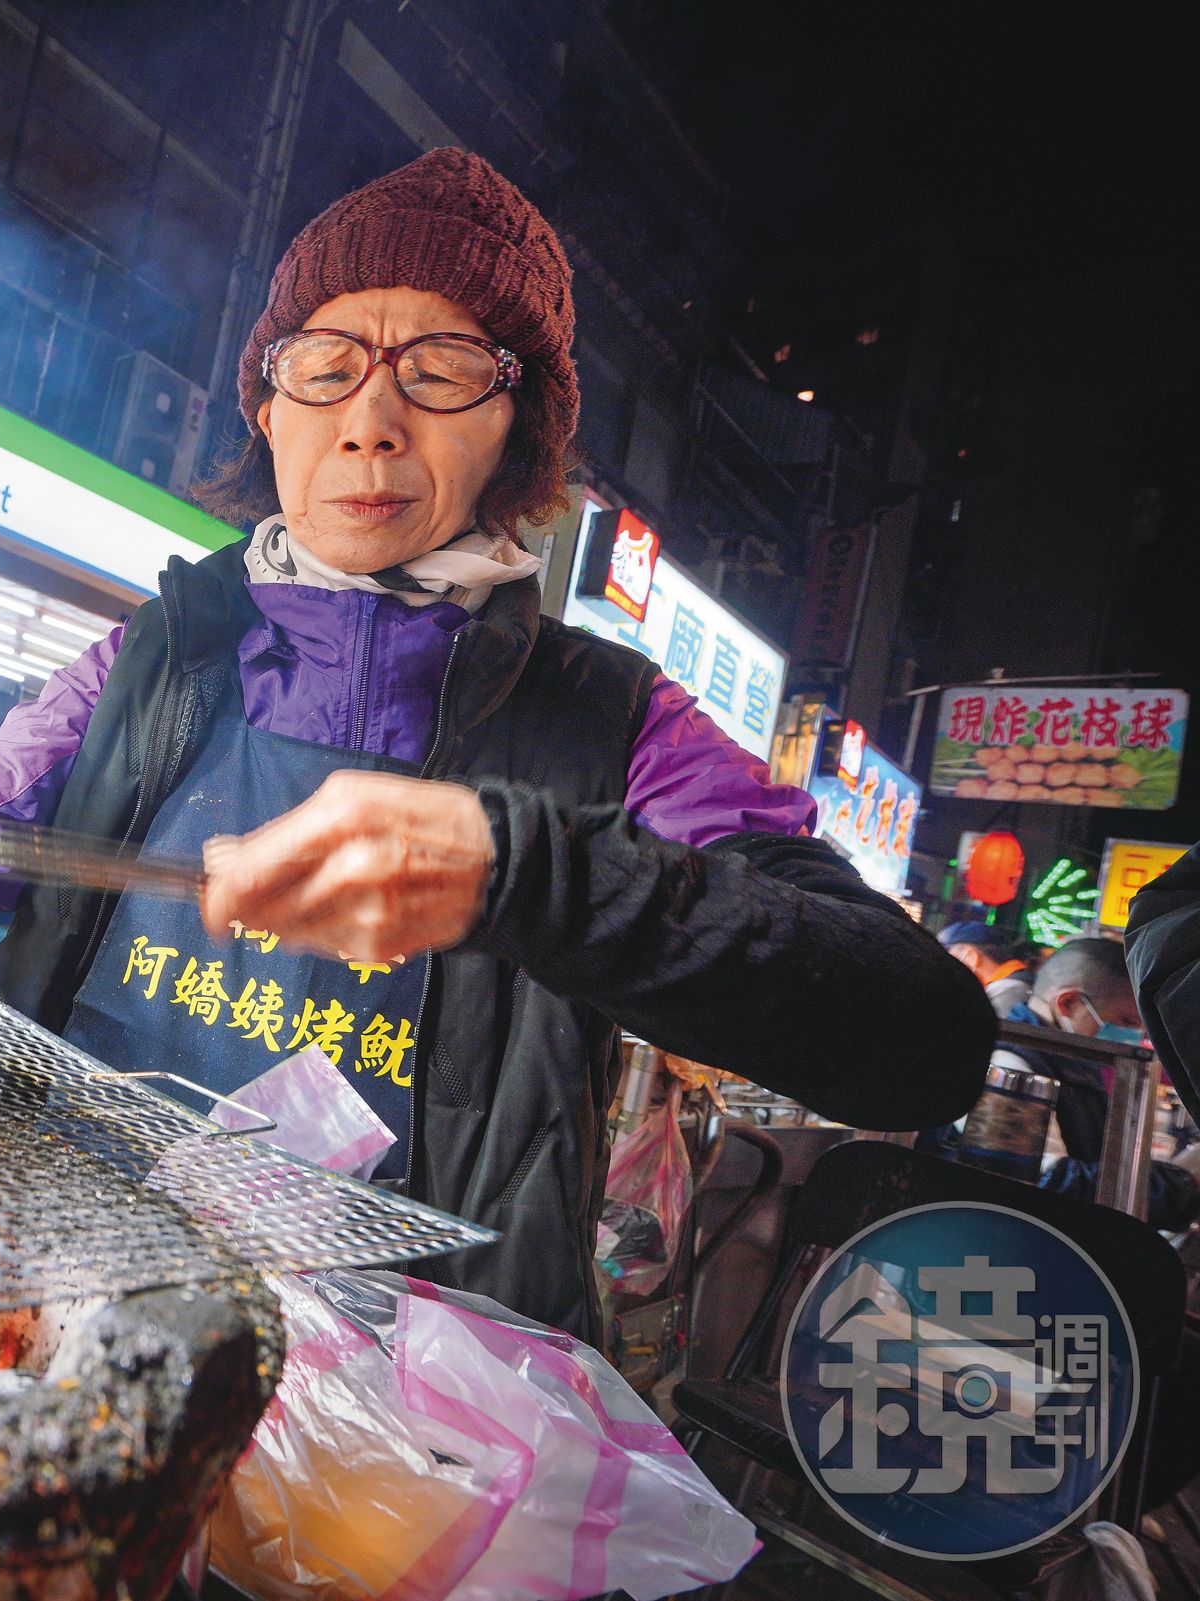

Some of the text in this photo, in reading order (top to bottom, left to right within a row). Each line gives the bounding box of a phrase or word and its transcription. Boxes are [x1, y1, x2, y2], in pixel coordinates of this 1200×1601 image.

[948, 696, 1174, 749] 現炸花枝球
[122, 935, 417, 1087] 阿嬌姨烤魷
